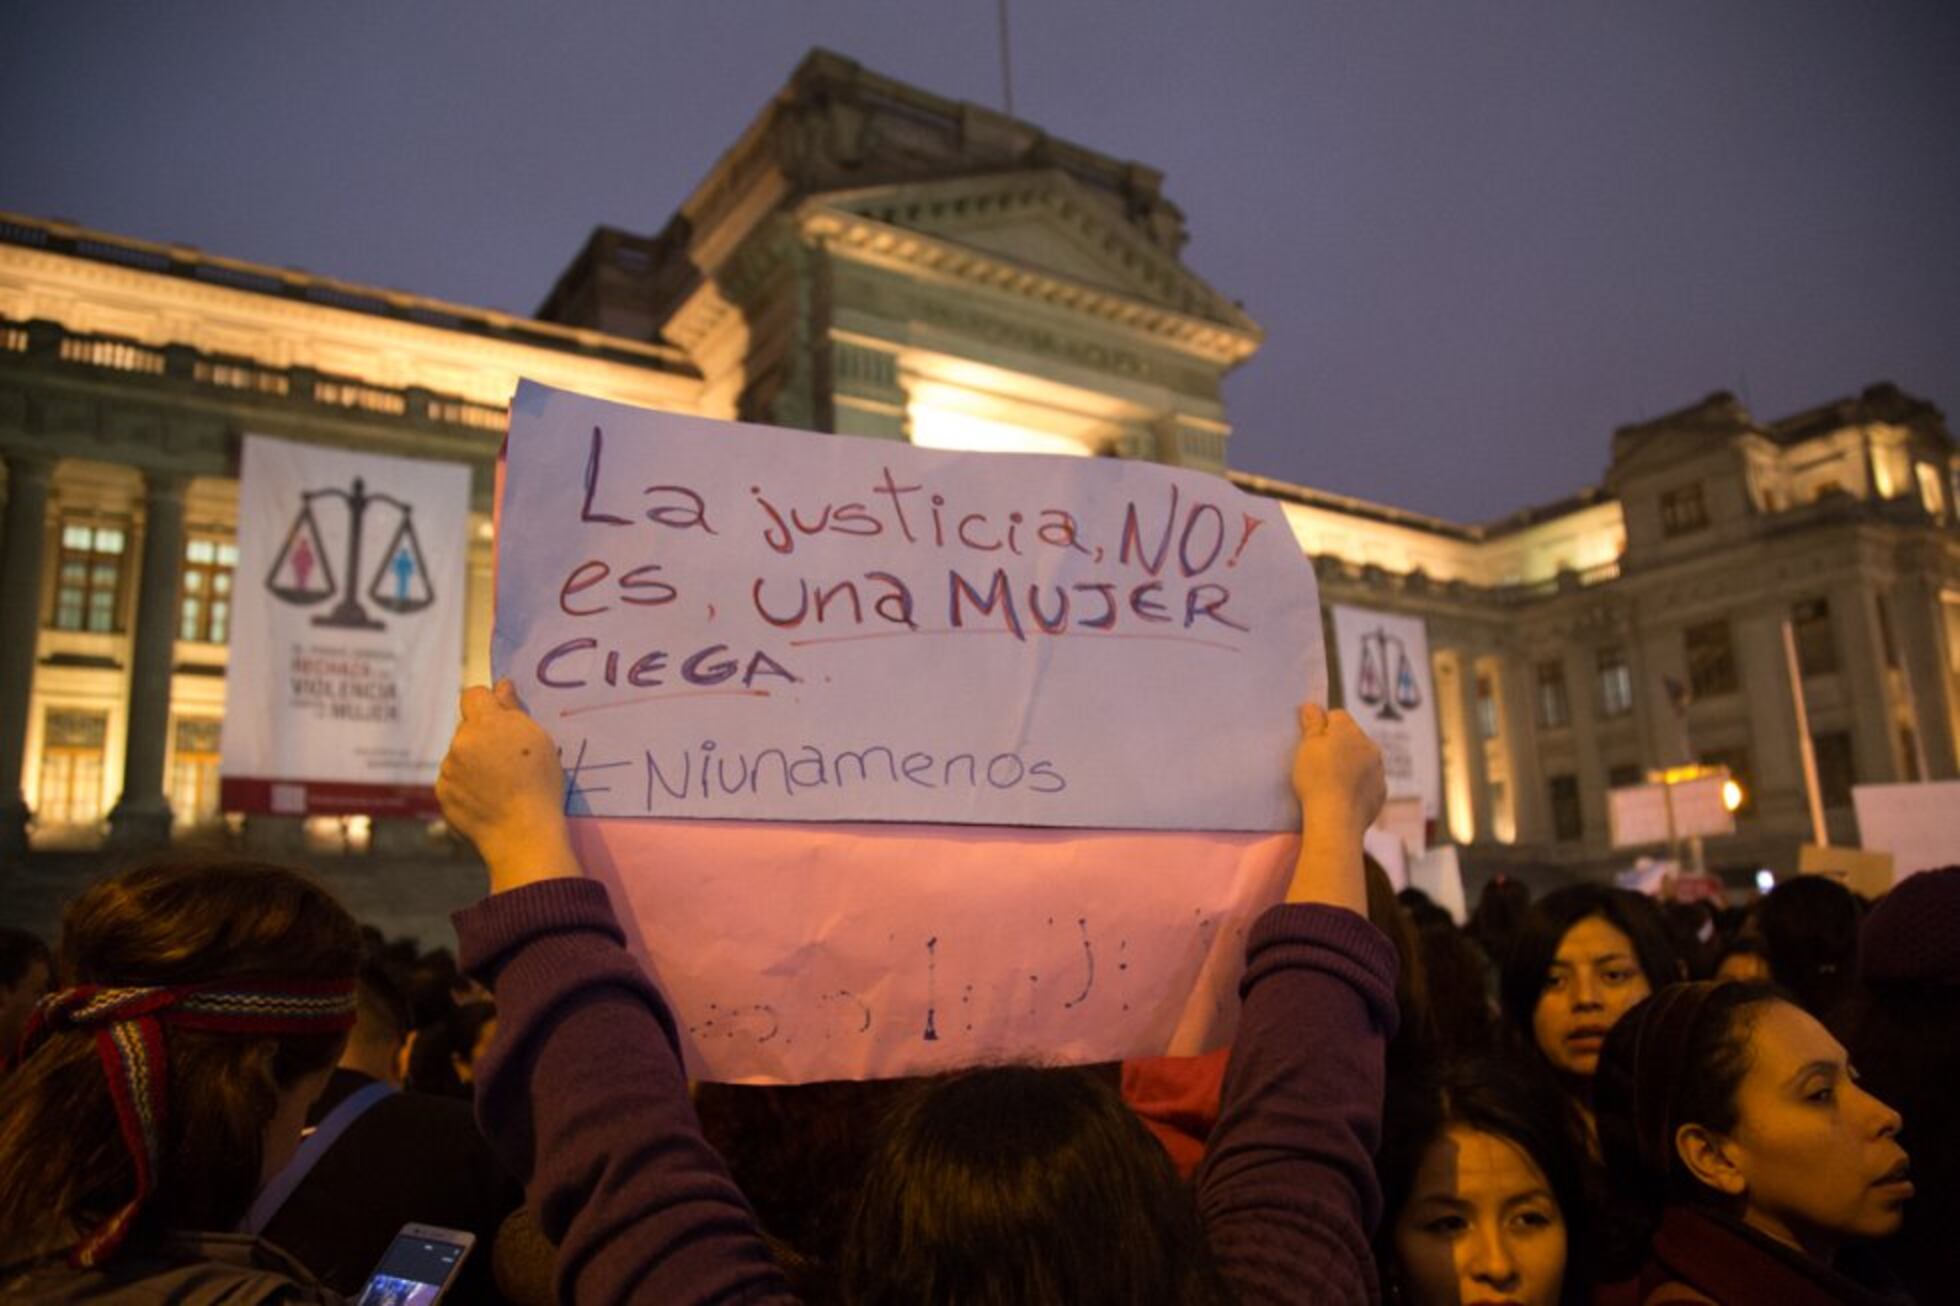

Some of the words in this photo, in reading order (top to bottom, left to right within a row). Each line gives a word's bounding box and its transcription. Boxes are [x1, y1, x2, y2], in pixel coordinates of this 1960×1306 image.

[581, 425, 719, 535] La
[1120, 483, 1265, 578] NO!
[949, 567, 1250, 642] MUJER
